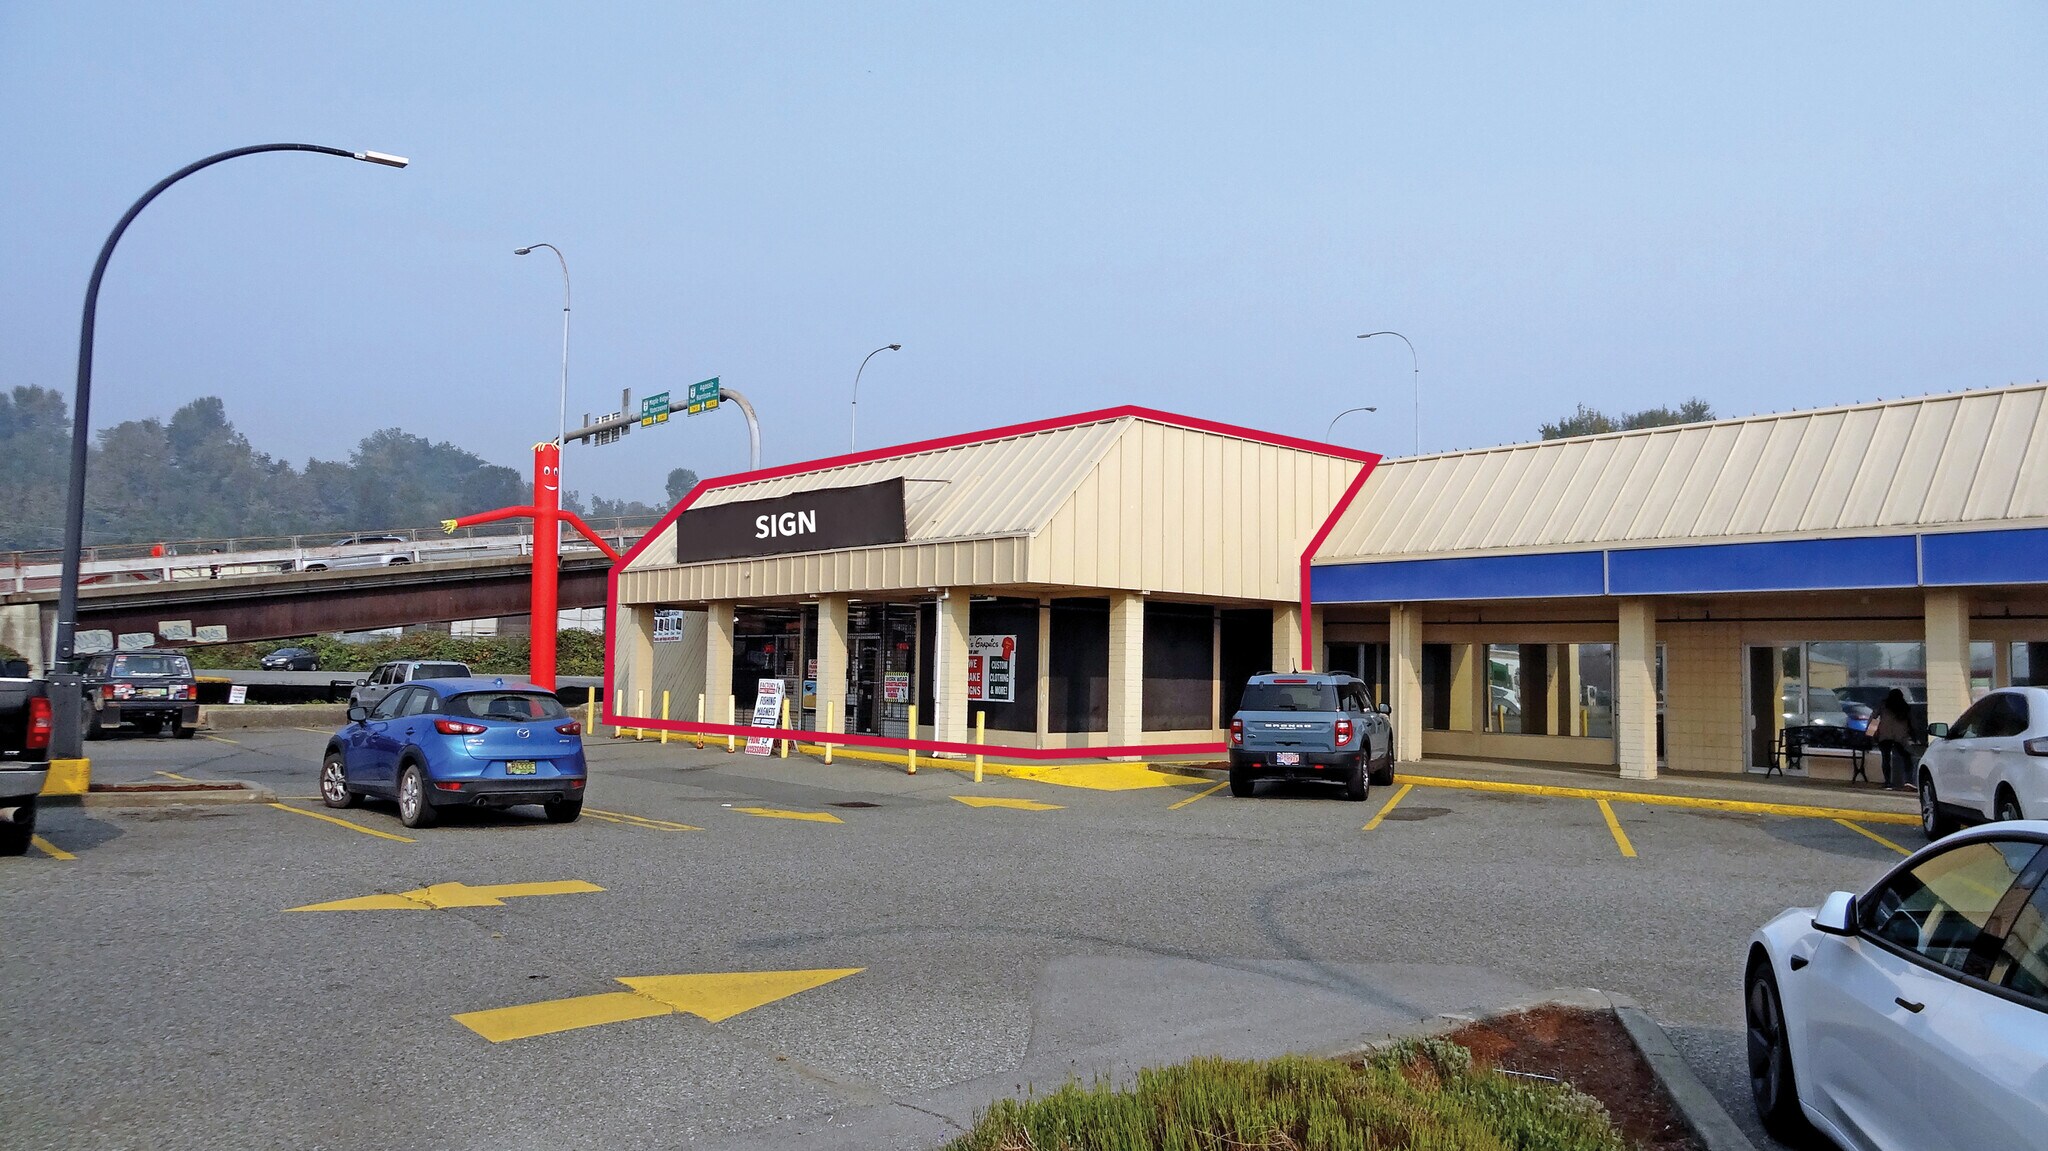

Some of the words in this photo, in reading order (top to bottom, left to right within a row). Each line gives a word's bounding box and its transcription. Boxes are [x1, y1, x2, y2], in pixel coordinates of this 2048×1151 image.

[755, 509, 816, 539] SIGN
[991, 661, 1008, 670] CUSTOM
[969, 673, 981, 682] AKE
[990, 674, 1009, 682] CLOTHING
[760, 696, 776, 706] FISHING
[757, 707, 776, 716] MAGNETS
[746, 746, 771, 755] ACCESSORIES
